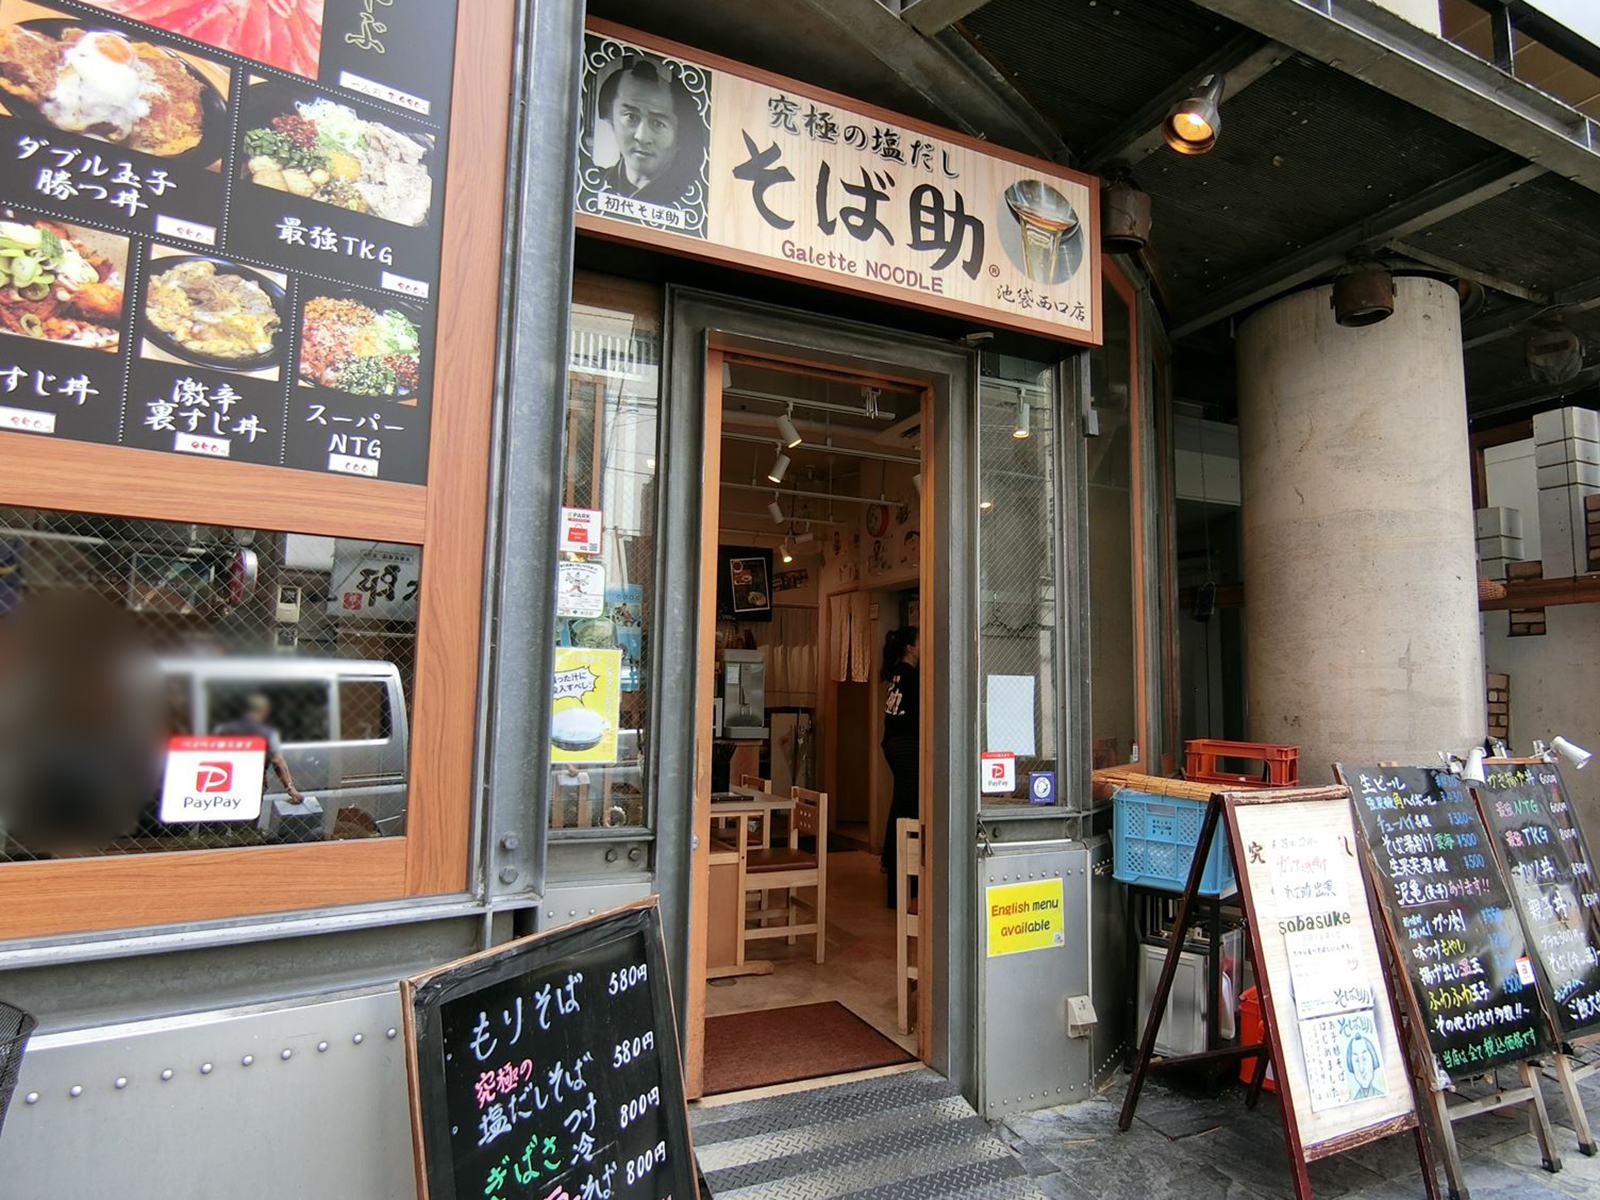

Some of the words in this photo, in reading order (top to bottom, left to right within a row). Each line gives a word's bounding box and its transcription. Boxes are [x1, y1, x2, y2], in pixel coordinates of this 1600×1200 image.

[345, 0, 393, 53] ぶ
[767, 96, 959, 179] 究極の塩だし
[16, 136, 177, 193] ダブル玉子
[36, 168, 148, 217] 勝つ丼
[604, 196, 680, 225] 初代そば助
[733, 129, 985, 281] そば助
[275, 217, 393, 266] 最強TKG
[782, 240, 858, 276] Galette
[865, 258, 945, 294] NOODLE
[996, 284, 1086, 321] 池袋西口店
[172, 377, 242, 415] 激辛
[144, 398, 267, 443] 裏すじ丼
[306, 404, 405, 431] スーパー
[328, 433, 381, 459] NTG
[183, 795, 241, 811] PayPay
[1359, 773, 1406, 794] 生ビール
[1248, 841, 1266, 864] 究
[991, 901, 1030, 917] English
[1032, 898, 1059, 911] menu
[1000, 919, 1051, 937] available
[1278, 911, 1351, 936] sobasuke
[470, 972, 584, 1060] もりそば
[608, 963, 648, 996] 580円
[1333, 987, 1370, 1008] そば助
[1428, 980, 1490, 1010] ふわふわ玉子
[1337, 1016, 1374, 1037] そば助
[475, 1058, 533, 1110] 究極の
[477, 1051, 594, 1146] 塩だしそば
[612, 1030, 655, 1069] 580円
[564, 1091, 597, 1133] つけ
[620, 1086, 660, 1129] 800円
[484, 1134, 561, 1194] ぎばさ
[571, 1131, 596, 1165] 冷
[626, 1140, 667, 1186] 800円
